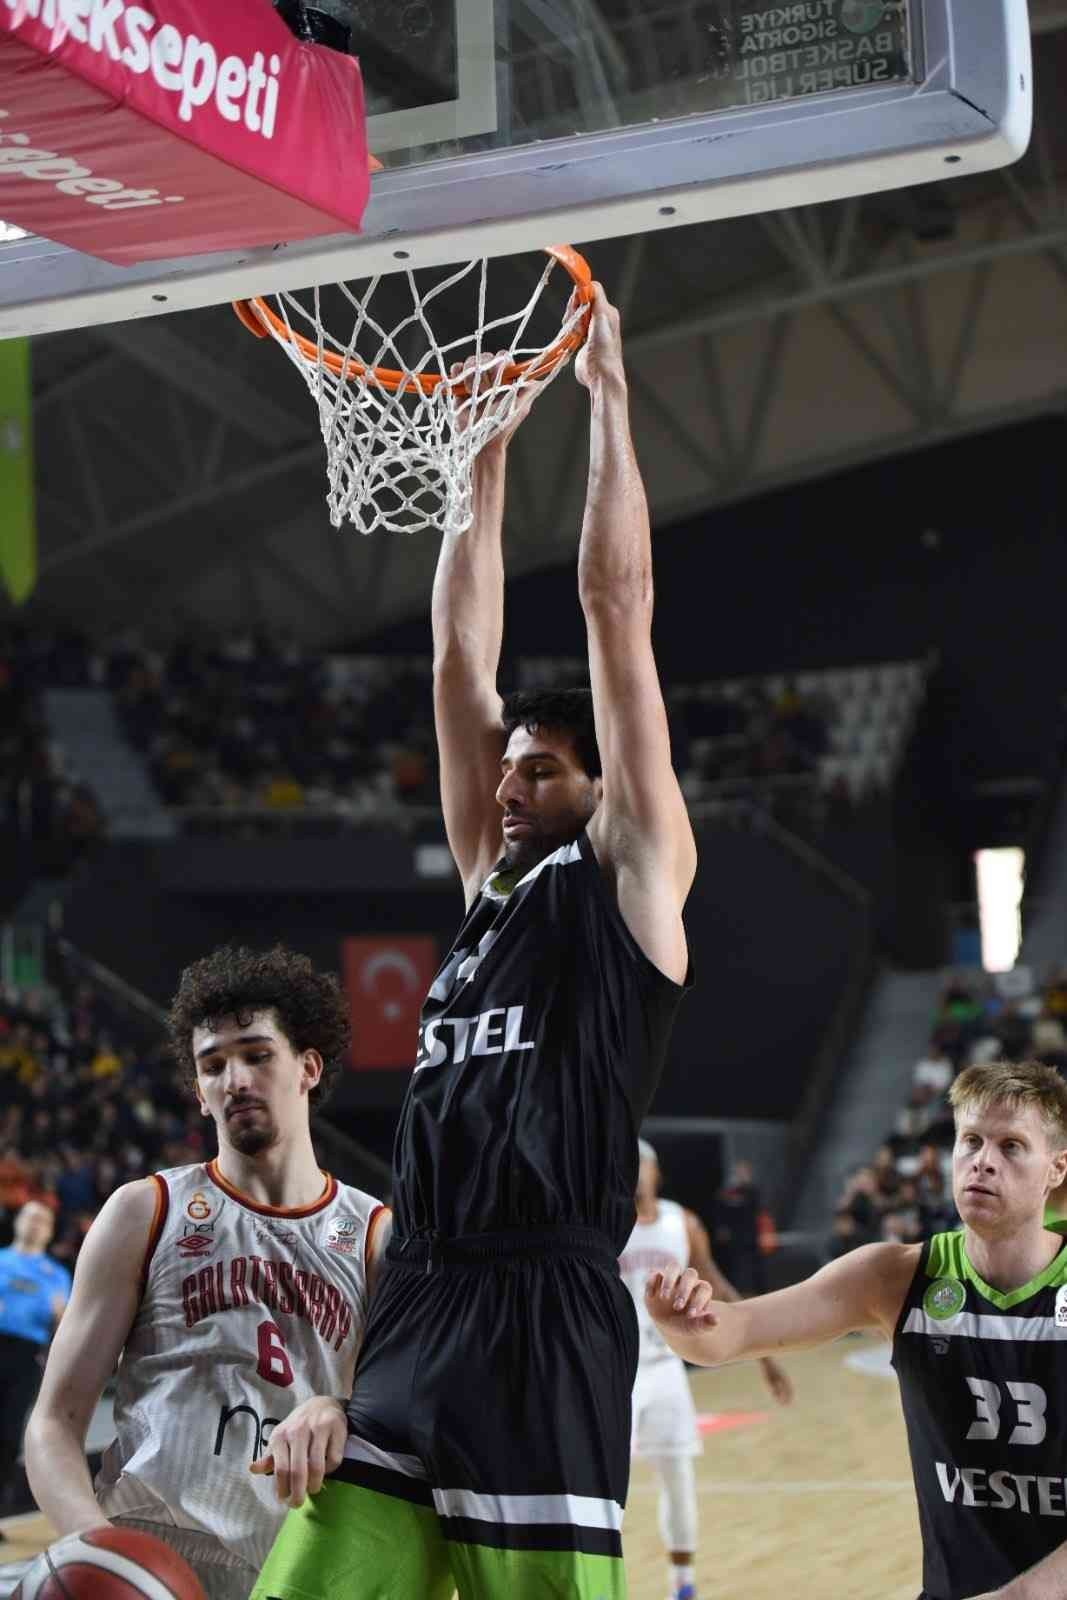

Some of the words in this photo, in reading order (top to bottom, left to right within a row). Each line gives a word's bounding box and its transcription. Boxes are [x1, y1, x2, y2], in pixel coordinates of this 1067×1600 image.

[5, 0, 281, 138] eksepeti
[413, 1005, 535, 1073] STEL
[257, 1320, 294, 1388] 6
[965, 1377, 1047, 1445] 33
[935, 1462, 1067, 1516] VESTE
